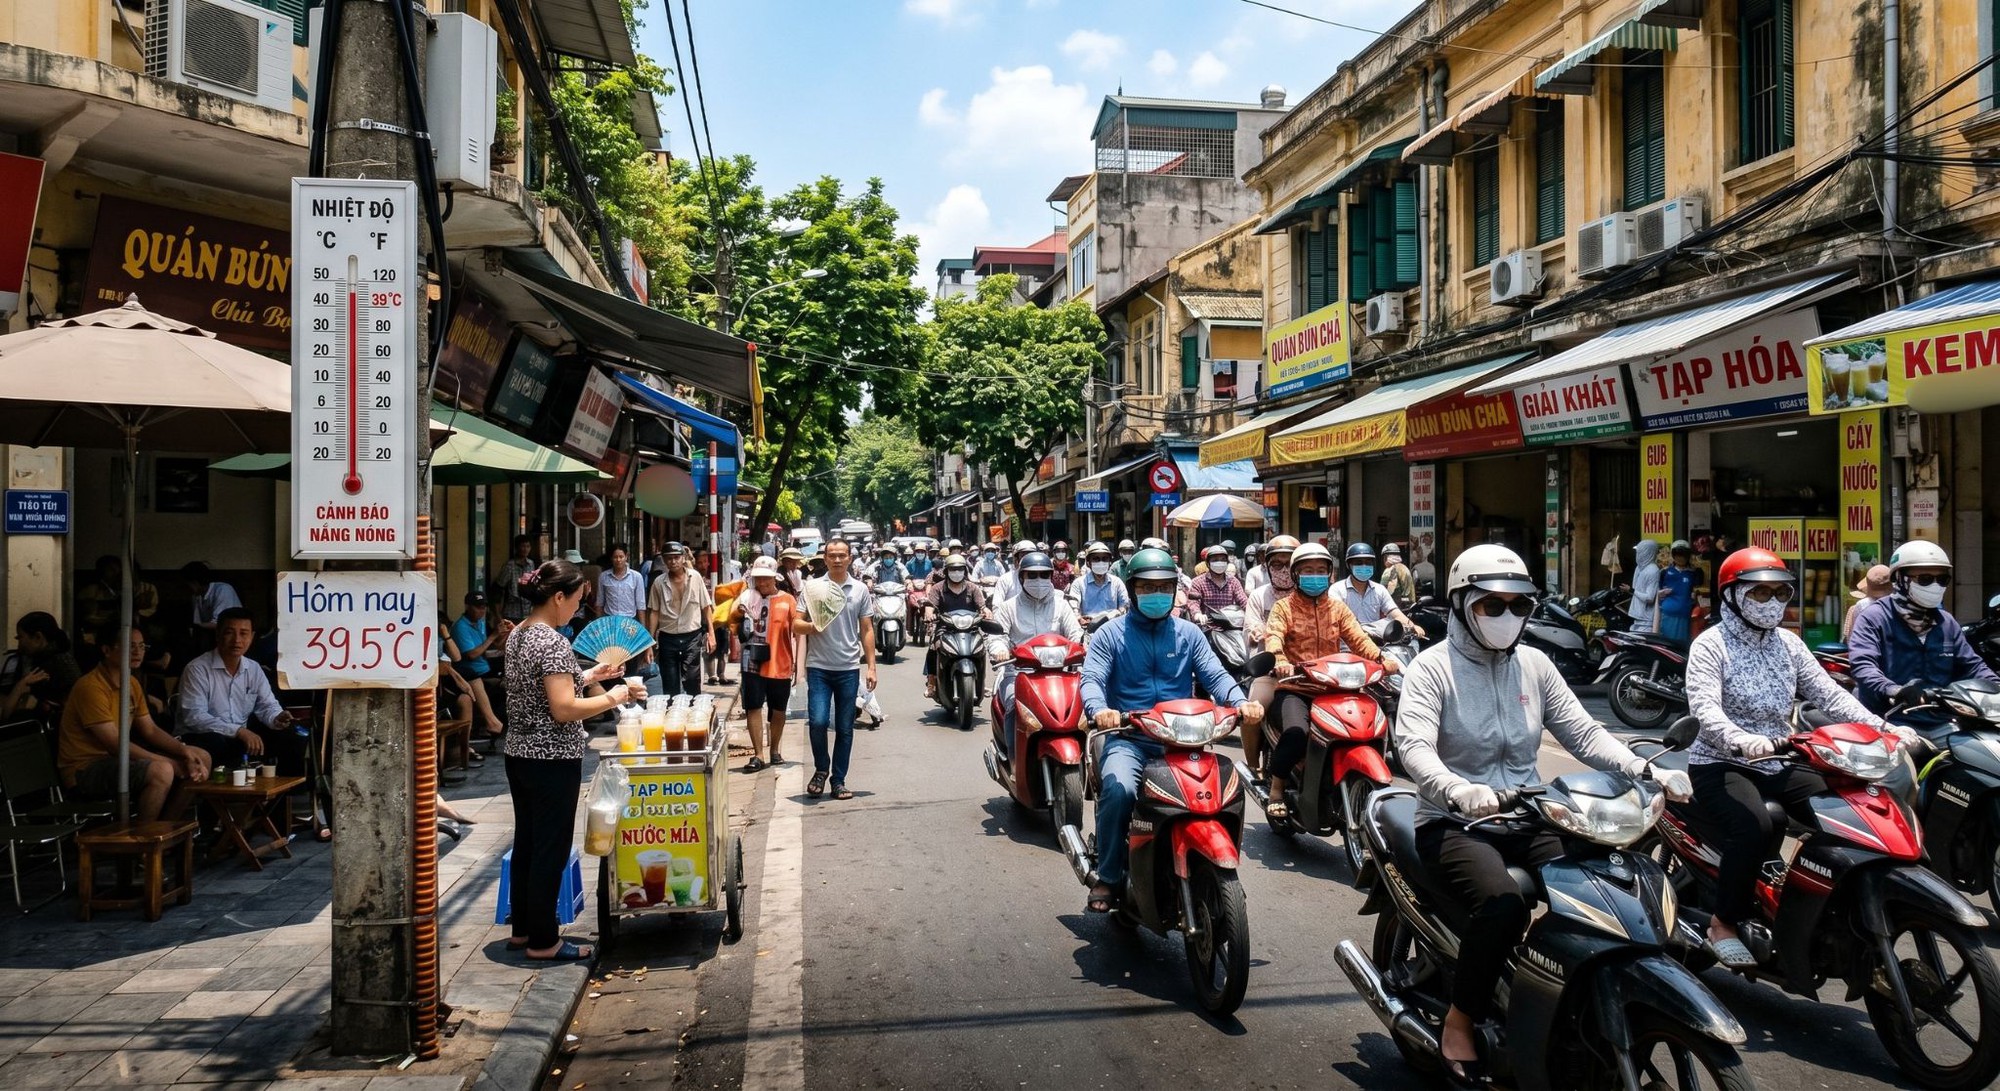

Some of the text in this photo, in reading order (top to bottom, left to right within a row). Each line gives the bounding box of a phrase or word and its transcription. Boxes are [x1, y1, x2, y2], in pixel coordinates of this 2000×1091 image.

[312, 197, 394, 223] NHIỆT ĐỘ
[317, 231, 336, 249] °C
[370, 232, 388, 250] °F
[122, 225, 292, 293] QUÁN BÚN
[313, 268, 329, 279] 50
[373, 270, 396, 281] 120
[313, 293, 329, 305] 40
[372, 292, 402, 306] 39°C
[211, 298, 255, 324] Chủ
[313, 319, 329, 330] 30
[375, 320, 391, 331] 80
[1271, 333, 1297, 367] QUÁN
[1298, 322, 1318, 355] BÚN
[1319, 310, 1341, 347] CHẢ
[313, 344, 329, 356] 20
[375, 345, 391, 357] 60
[1904, 328, 2000, 379] KEM
[314, 369, 329, 381] 10
[375, 370, 391, 382] 40
[1651, 335, 1804, 405] TẠP HÓA
[318, 395, 326, 407] 6
[375, 396, 391, 408] 20
[1522, 374, 1617, 420] GIẢI KHÁT
[1474, 395, 1510, 429] CHẢ
[314, 421, 329, 433] 10
[379, 422, 387, 434] 0
[313, 447, 329, 459] 20
[375, 448, 391, 460] 20
[1646, 470, 1667, 500] GIẢI
[1843, 459, 1877, 491] NƯỚC
[316, 500, 389, 520] CẢNH BÁO
[1644, 506, 1670, 534] KHÁT
[1848, 498, 1873, 531] MÍA
[355, 524, 395, 542] NÓNG
[1780, 524, 1800, 552] MÍA
[1807, 529, 1838, 552] KEM
[288, 581, 416, 625] Hôm nay
[302, 622, 431, 670] 39.5°C!
[621, 820, 700, 845] NƯỚC MÍA
[1800, 856, 1832, 879] YAMAHA
[1528, 946, 1564, 976] YAMAHA
